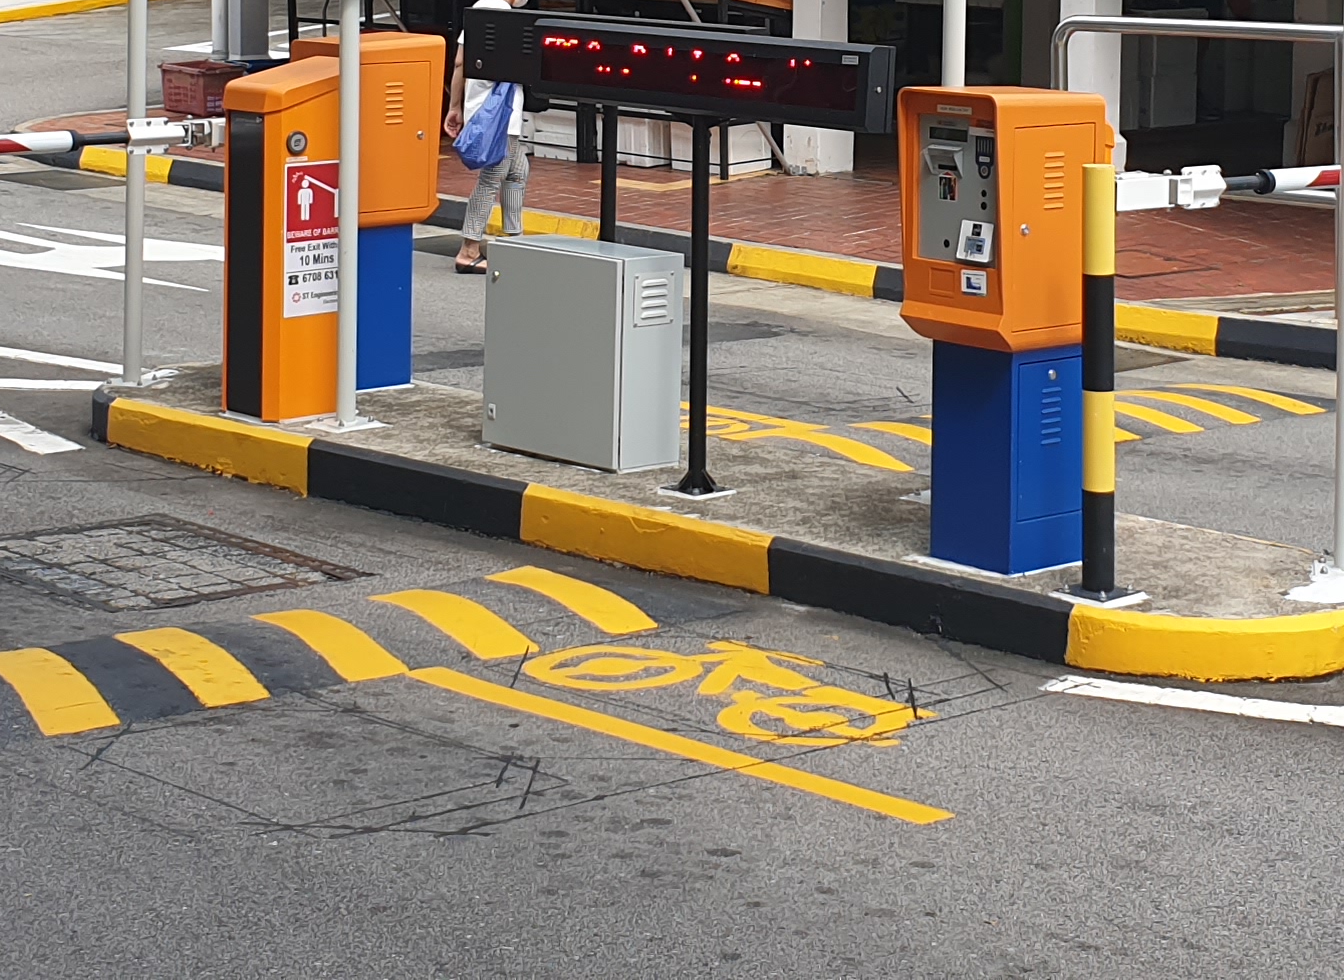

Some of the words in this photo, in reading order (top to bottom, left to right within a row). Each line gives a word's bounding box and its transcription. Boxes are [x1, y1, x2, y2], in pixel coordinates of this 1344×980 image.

[312, 227, 322, 236] OF
[322, 226, 339, 236] BARR
[290, 244, 306, 253] Free
[307, 243, 321, 251] Exit
[299, 254, 310, 266] 10
[312, 253, 335, 265] Mins
[302, 272, 322, 283] 6708
[324, 270, 339, 280] 631
